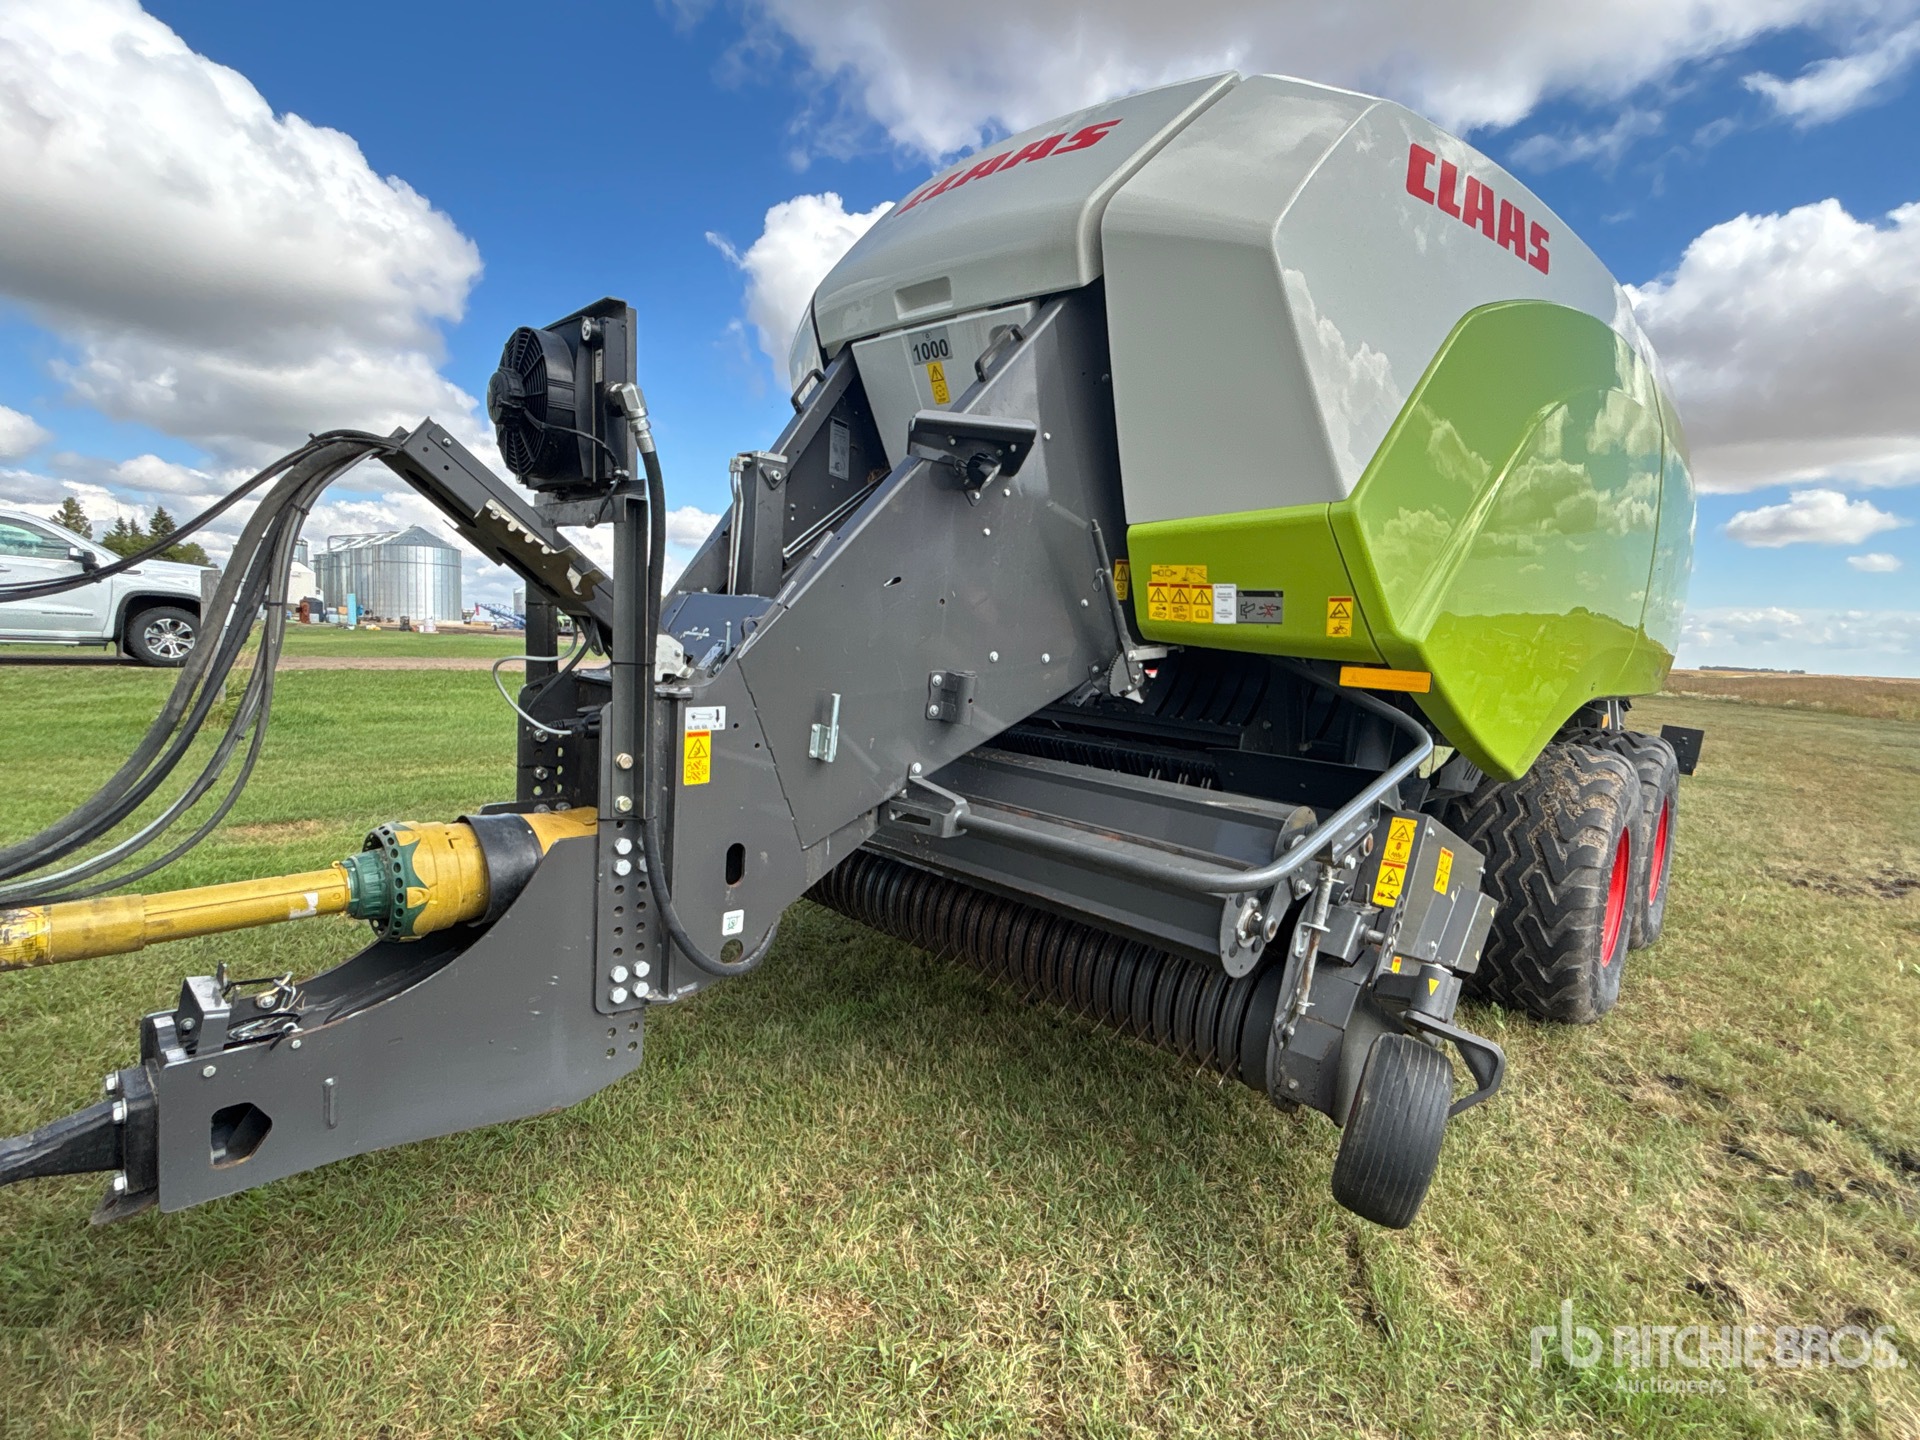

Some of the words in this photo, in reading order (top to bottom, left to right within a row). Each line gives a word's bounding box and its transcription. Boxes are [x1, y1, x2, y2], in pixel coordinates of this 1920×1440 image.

[893, 118, 1123, 218] CLAAS
[1406, 143, 1549, 275] CLAAS
[913, 339, 949, 362] 1000
